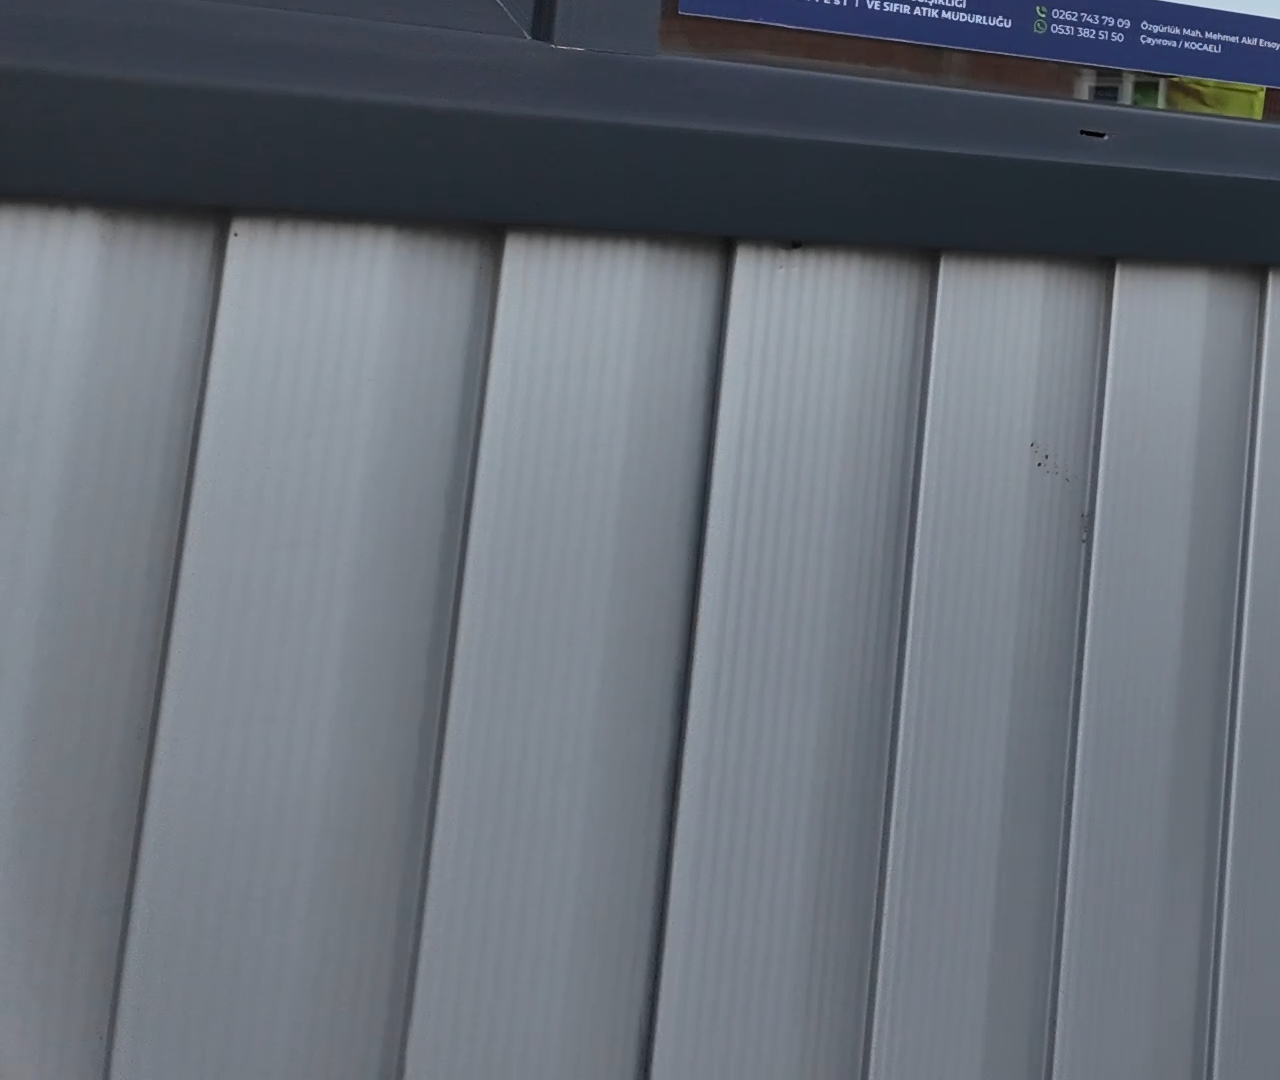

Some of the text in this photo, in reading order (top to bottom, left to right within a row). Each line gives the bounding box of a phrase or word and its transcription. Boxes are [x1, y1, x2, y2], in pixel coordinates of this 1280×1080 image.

[866, 0, 939, 19] VE SIFIR ATIK
[1051, 8, 1131, 29] 0262 743 79 09
[1050, 23, 1124, 43] 0531 382 51 50
[1205, 30, 1239, 43] Mehmet
[1241, 36, 1258, 46] Akif
[1259, 38, 1280, 51] Ersoy
